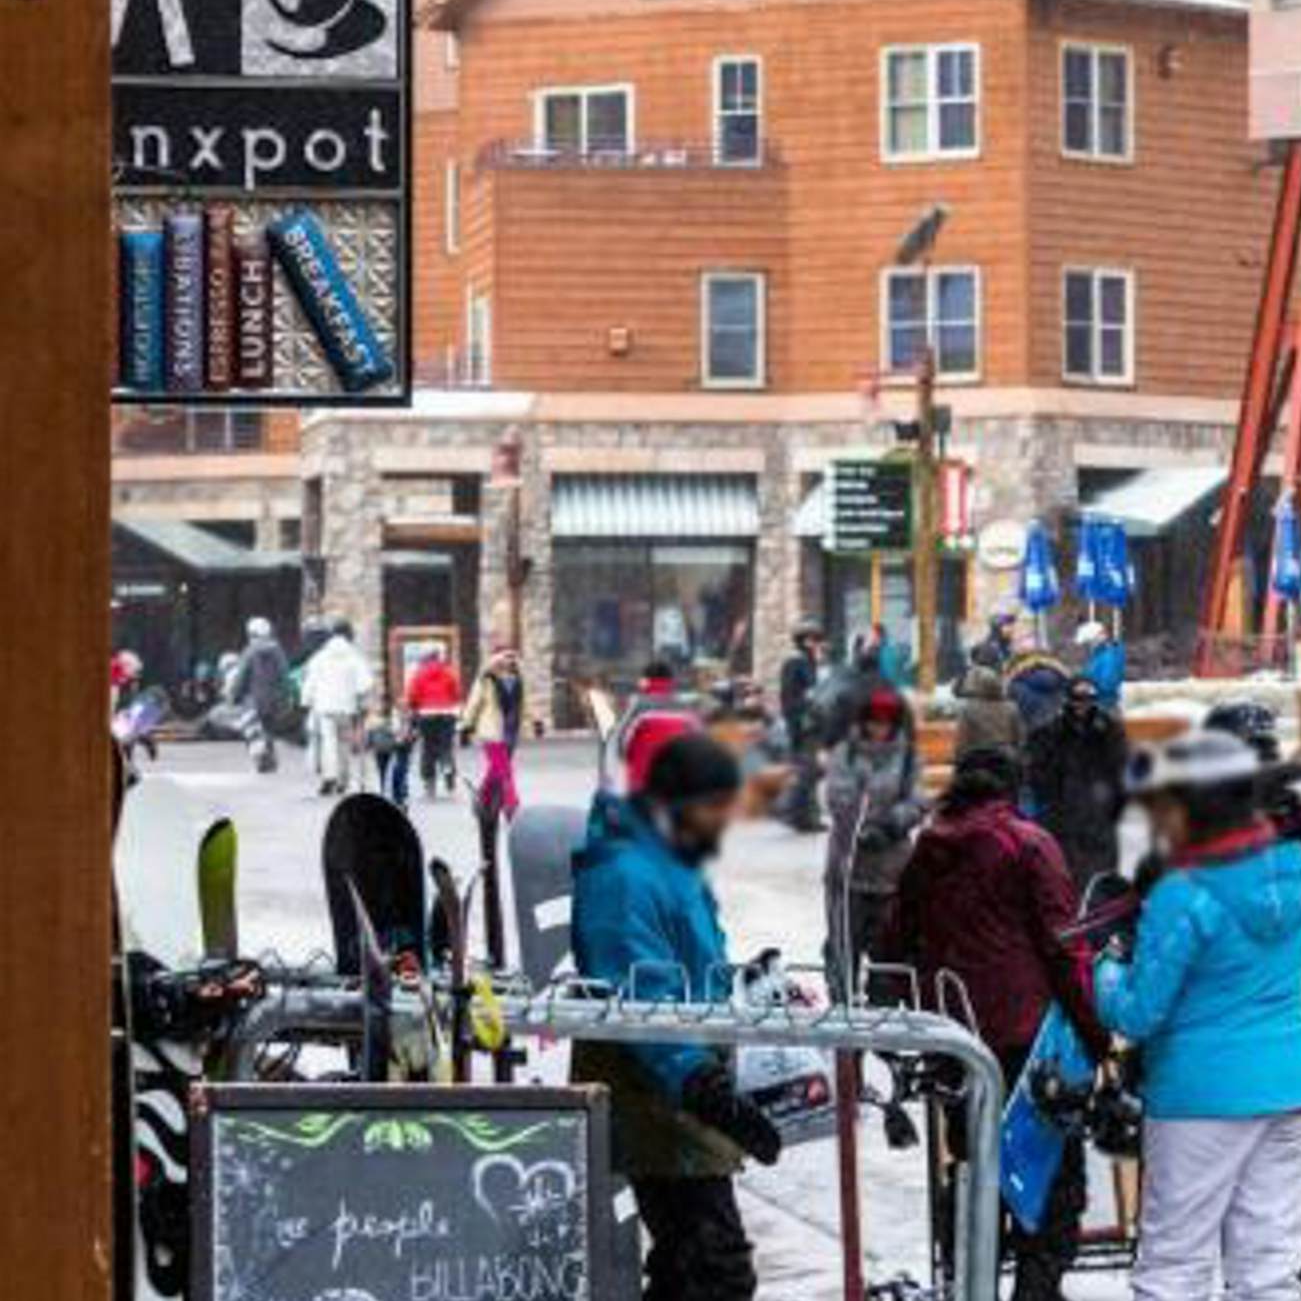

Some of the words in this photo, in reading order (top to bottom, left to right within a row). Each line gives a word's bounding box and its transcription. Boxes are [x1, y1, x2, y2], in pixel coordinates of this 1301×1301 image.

[208, 268, 232, 382] ESPRESSO
[240, 259, 267, 379] LUNCH
[284, 223, 375, 373] BREAKFAST
[410, 1254, 587, 1301] BILLABONG
